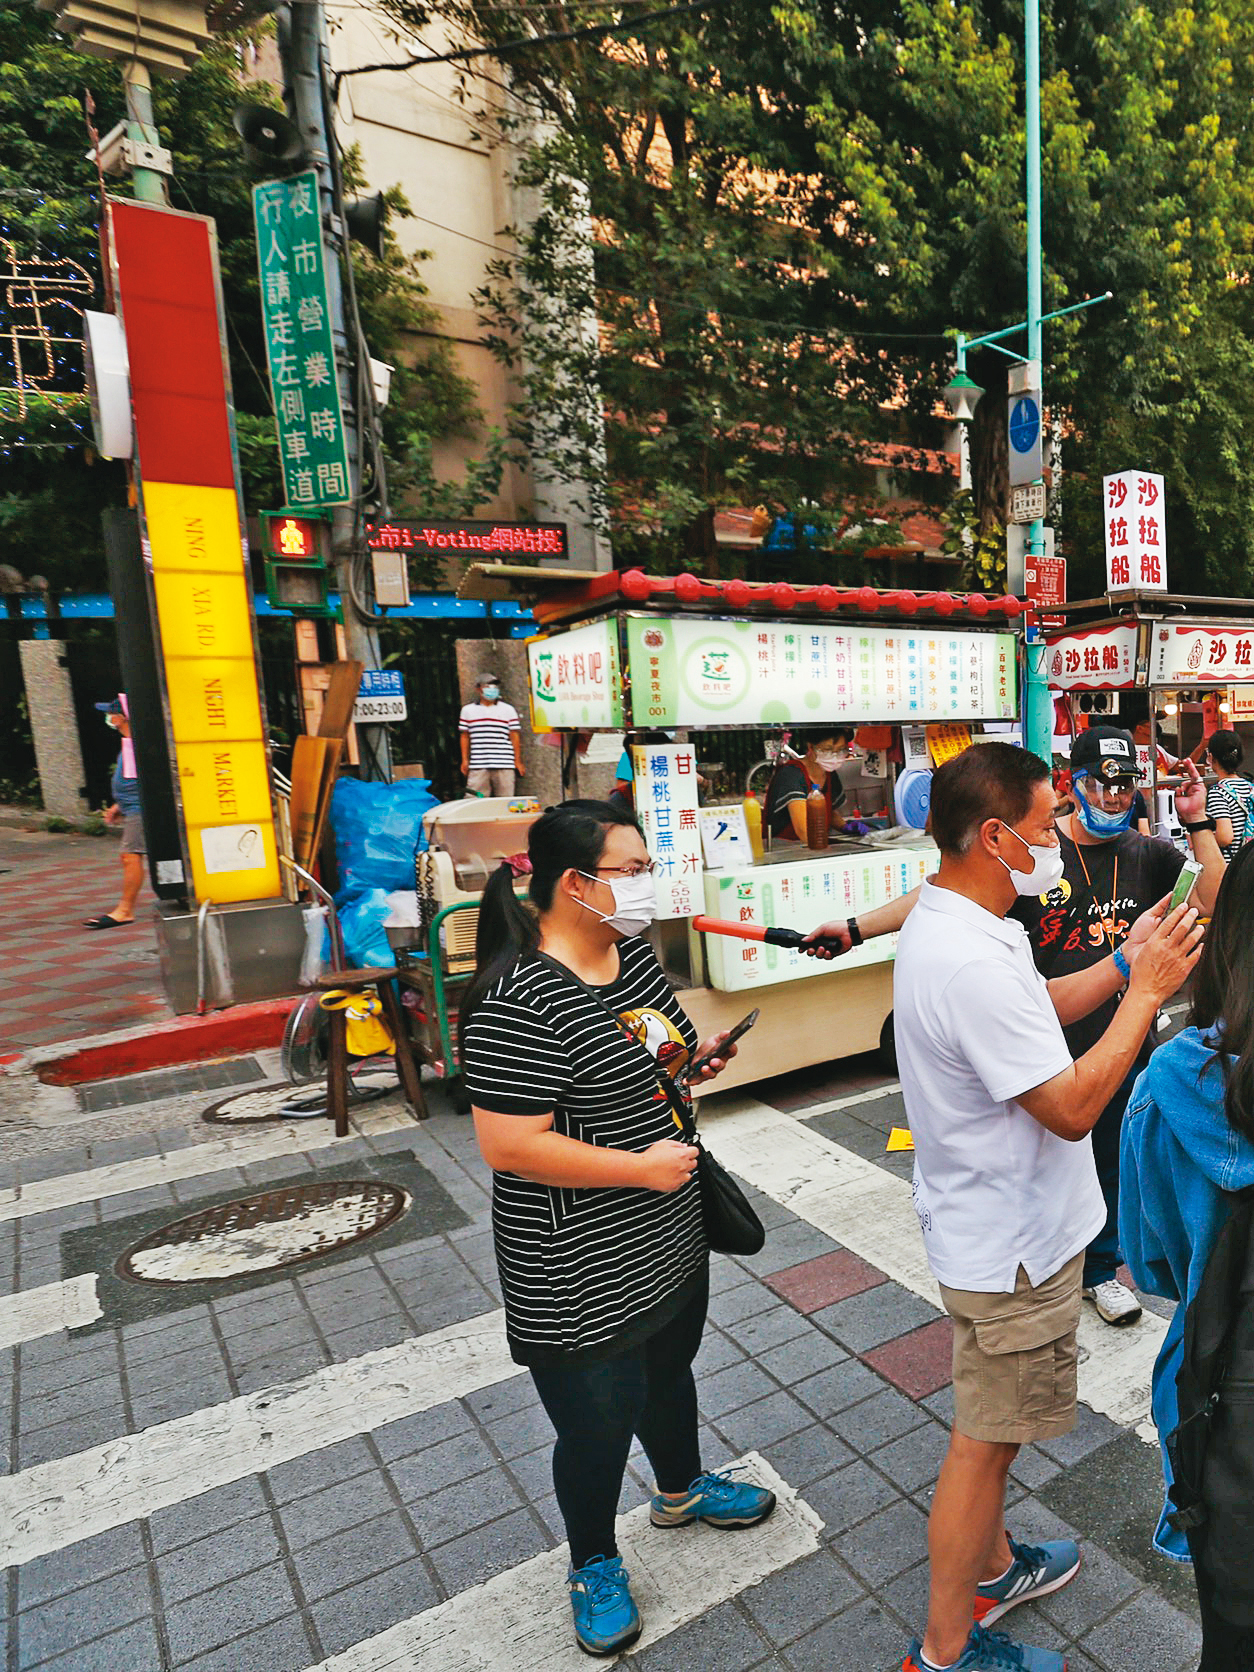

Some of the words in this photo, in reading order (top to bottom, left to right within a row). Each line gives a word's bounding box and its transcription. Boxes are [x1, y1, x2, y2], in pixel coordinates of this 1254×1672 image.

[259, 187, 315, 503] 行人請走左側車道
[289, 181, 346, 499] 夜市營業時間
[184, 516, 207, 559] NING
[1108, 478, 1130, 585] 沙拉船
[1138, 477, 1161, 584] 沙拉船
[192, 586, 212, 616] XIA
[198, 624, 215, 651] RD.
[758, 633, 769, 679] 楊桃汁
[784, 634, 795, 679] 檸檬汁
[811, 635, 821, 679] 甘蔗汁
[1066, 645, 1118, 672] 沙拉船
[558, 651, 602, 685] 飲料吧
[650, 656, 661, 703] 寧夏夜市
[835, 636, 847, 711] 牛奶甘蔗汁
[885, 638, 896, 710] 楊桃甘蔗汁
[203, 678, 227, 729] NIGHT
[649, 707, 667, 716] 001
[213, 752, 239, 818] MARKET
[650, 755, 675, 878] 楊桃甘蔗汁
[675, 753, 700, 874] 甘蔗汁
[671, 887, 690, 896] 55
[672, 906, 692, 914] 45
[740, 906, 758, 962] 飲吧
